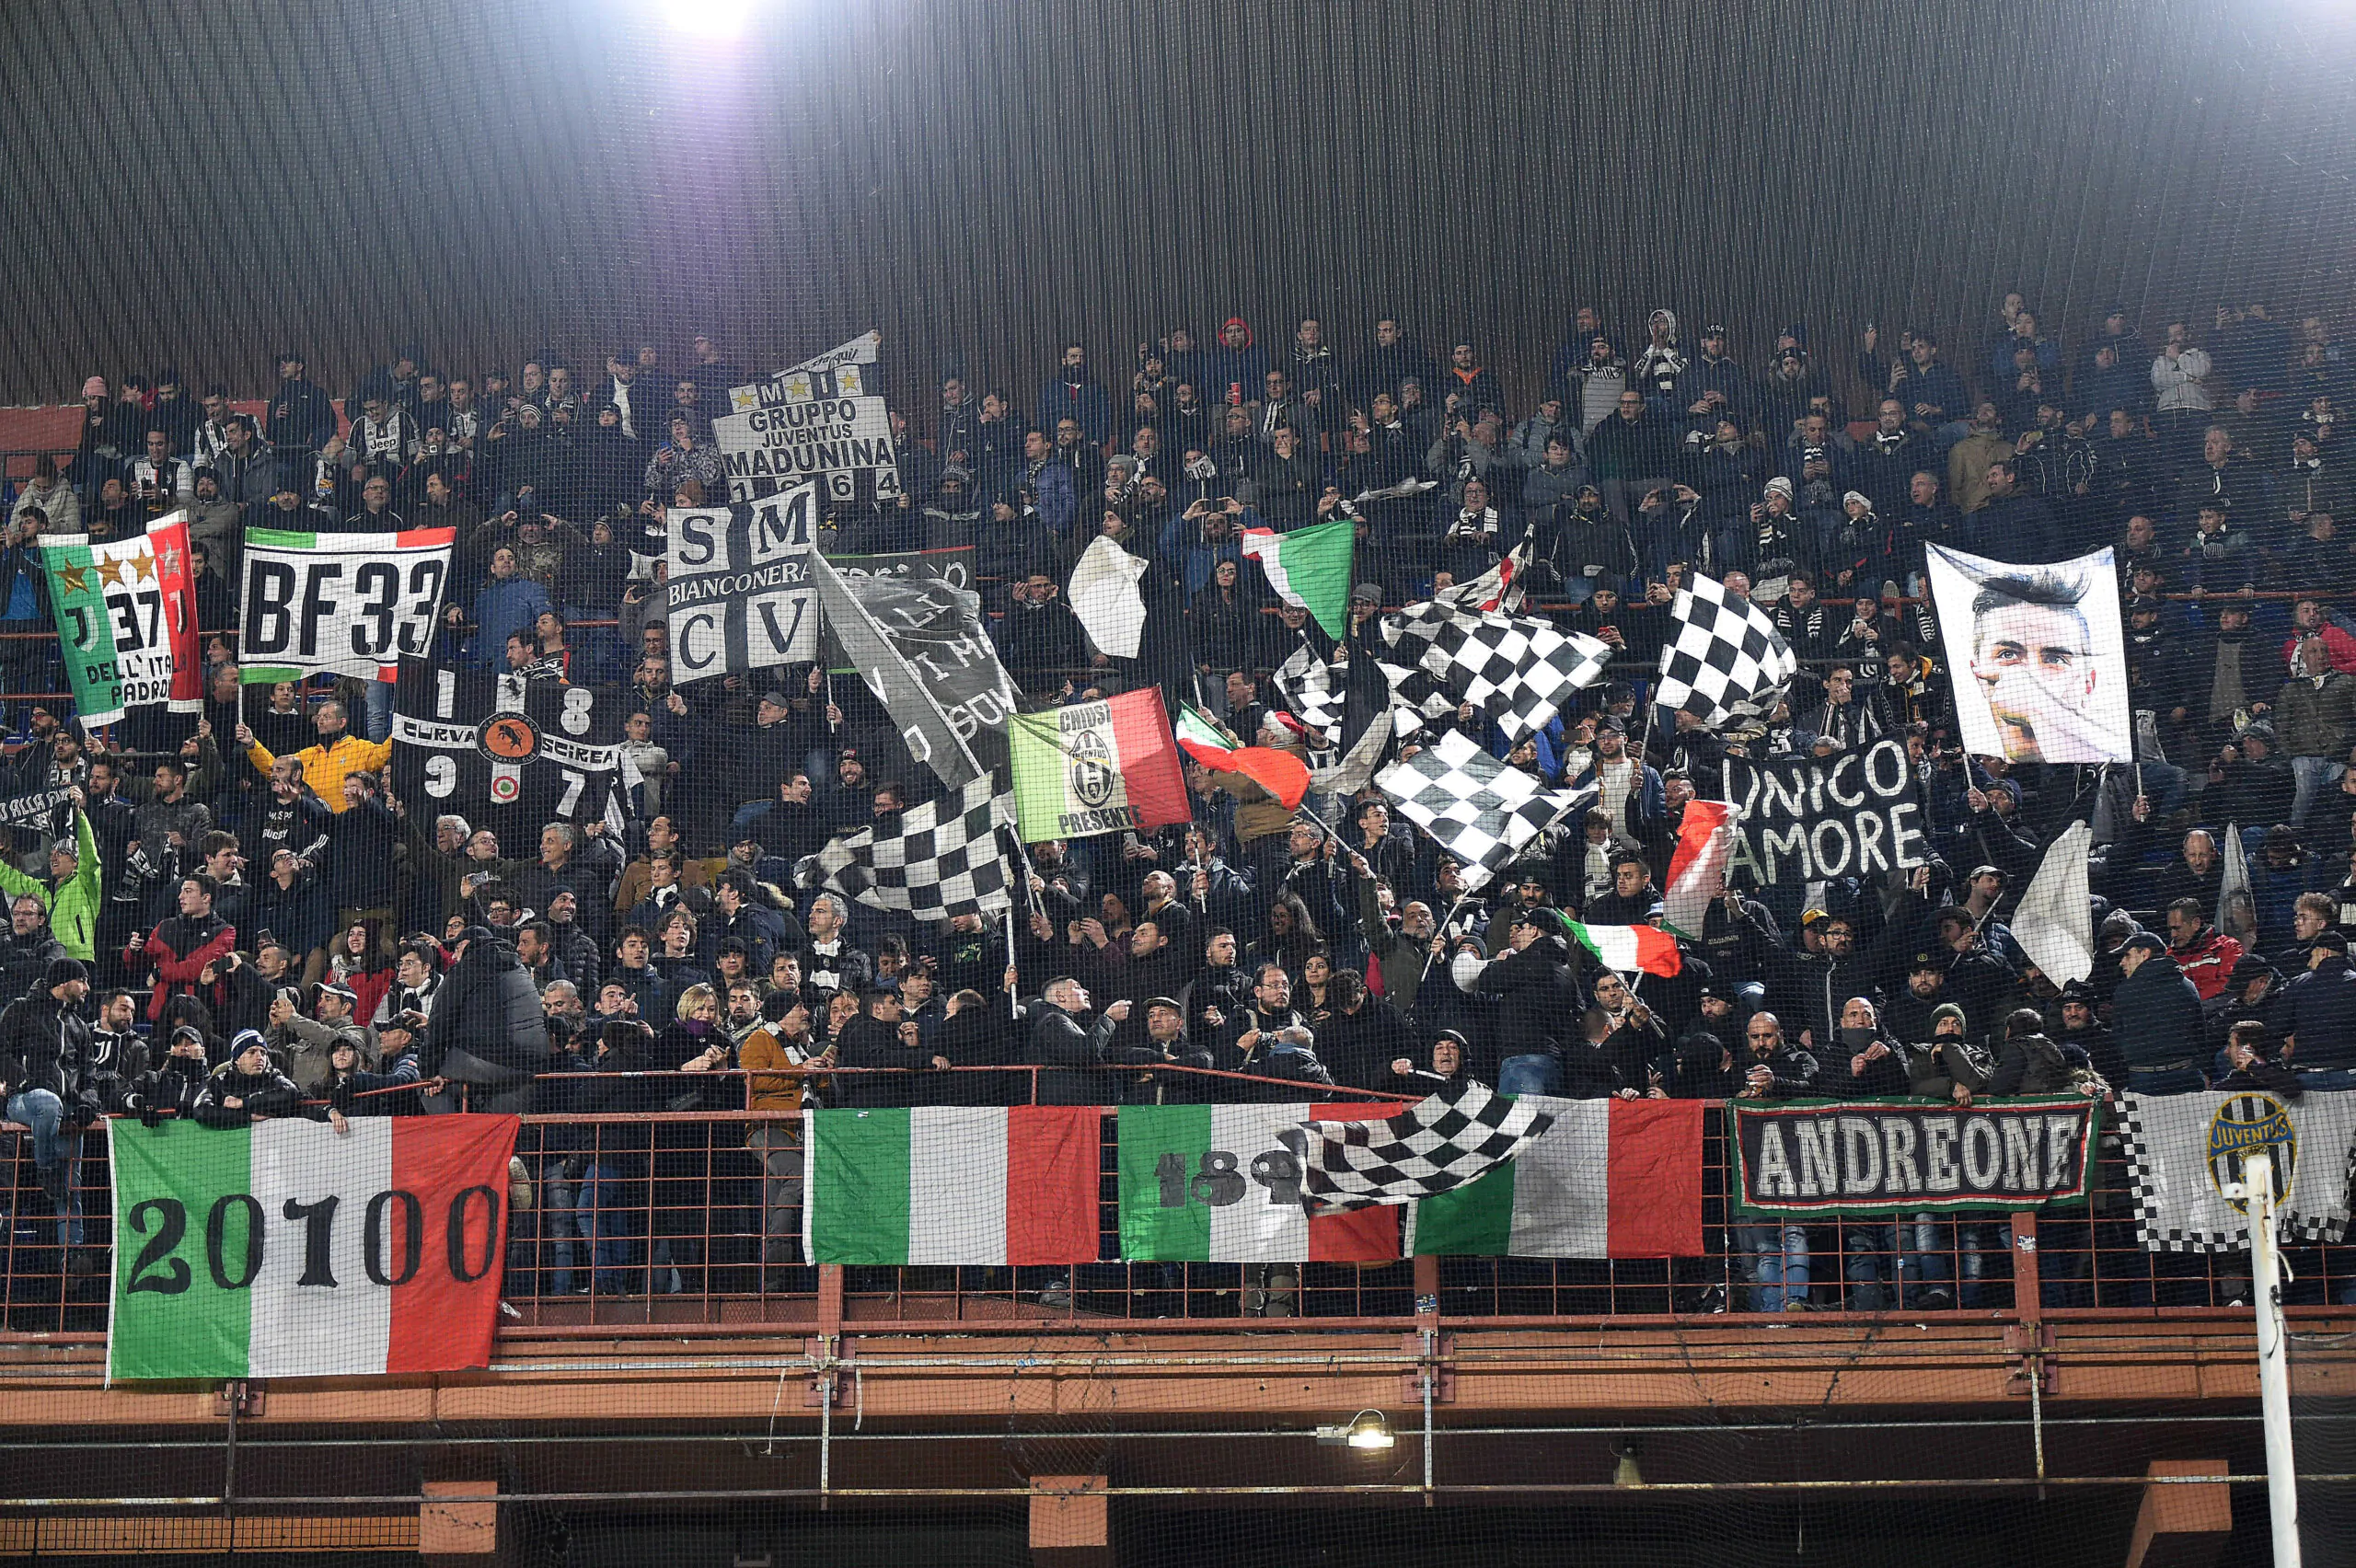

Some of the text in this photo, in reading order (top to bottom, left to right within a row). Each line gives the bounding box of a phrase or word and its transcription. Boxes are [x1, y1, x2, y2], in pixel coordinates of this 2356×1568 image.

[748, 399, 857, 432] GRUPPO
[761, 423, 853, 448] JUVENTUS
[370, 438, 397, 450] Jeep
[722, 437, 895, 477] MADUNINA
[678, 490, 811, 566] S M
[105, 589, 161, 653] 37
[245, 559, 444, 656] BF33
[679, 597, 807, 670] C V
[403, 721, 476, 743] CURVA
[483, 747, 537, 763] FOOTBALL CLUB
[1722, 740, 1908, 821] UNICO
[9, 793, 45, 818] ALLA
[1058, 804, 1145, 835] PRESENTE
[1725, 802, 1927, 886] AMORE
[1755, 1115, 2080, 1196] ANDREONE
[2211, 1113, 2289, 1149] JUVENTUS
[1153, 1149, 1302, 1207] 189
[126, 1184, 500, 1295] 20100
